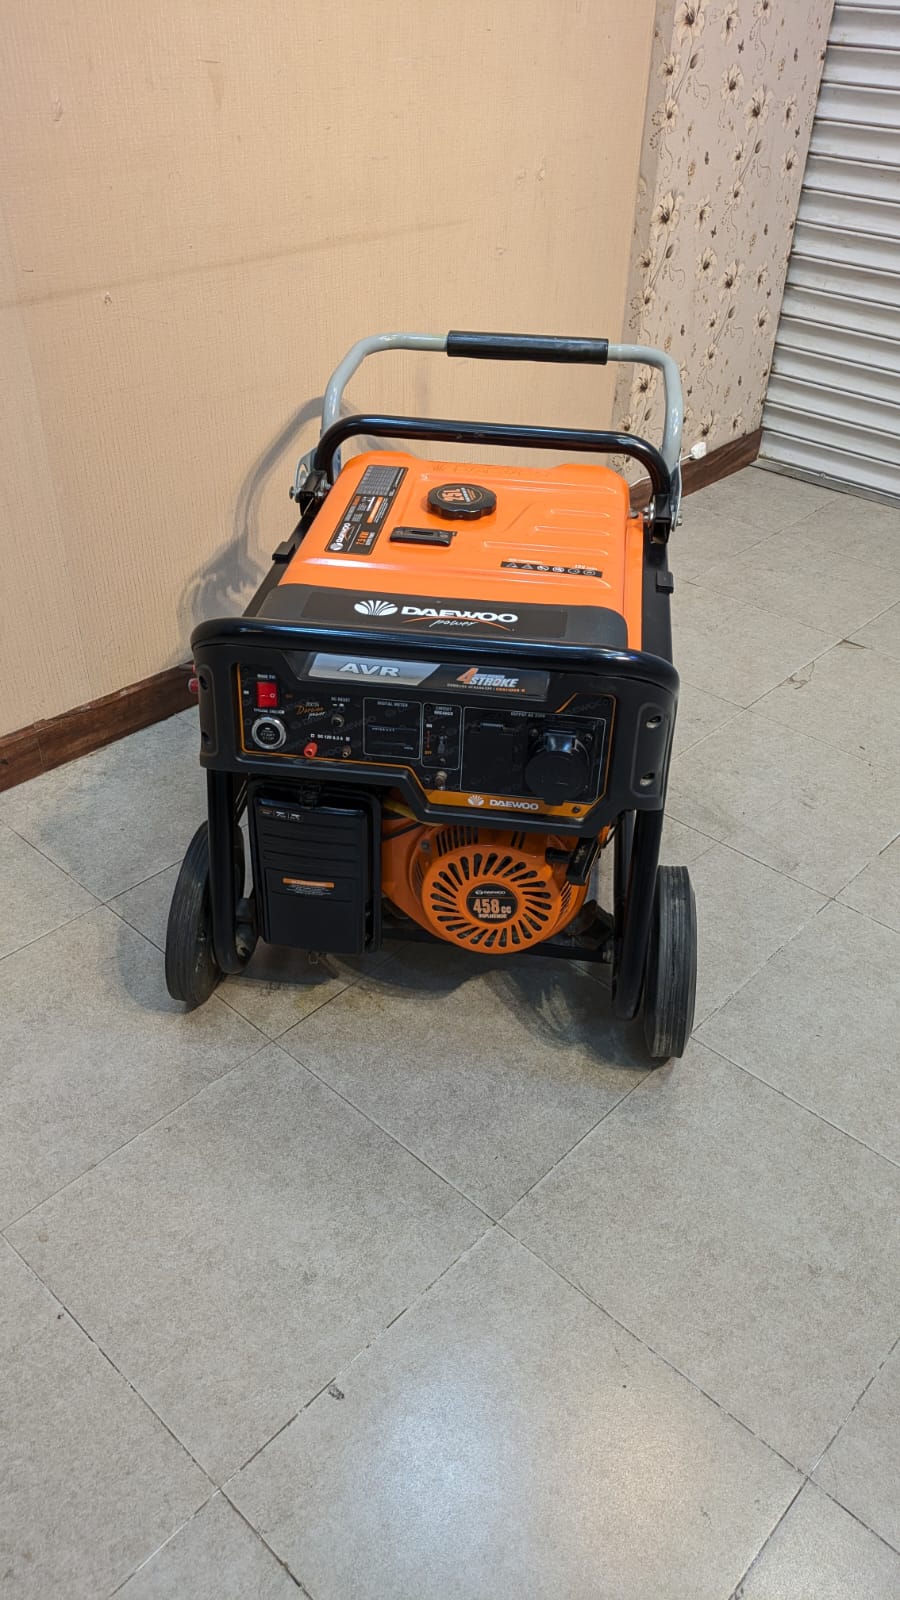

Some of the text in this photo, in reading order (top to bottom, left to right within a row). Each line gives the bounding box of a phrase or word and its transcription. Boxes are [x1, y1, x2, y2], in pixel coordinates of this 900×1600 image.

[401, 606, 519, 624] DAEWOO
[428, 618, 480, 628] power
[339, 663, 401, 677] AVR
[456, 667, 479, 684] 4
[469, 677, 519, 688] STROKE
[489, 800, 540, 810] DAEWOO
[473, 899, 500, 914] 458
